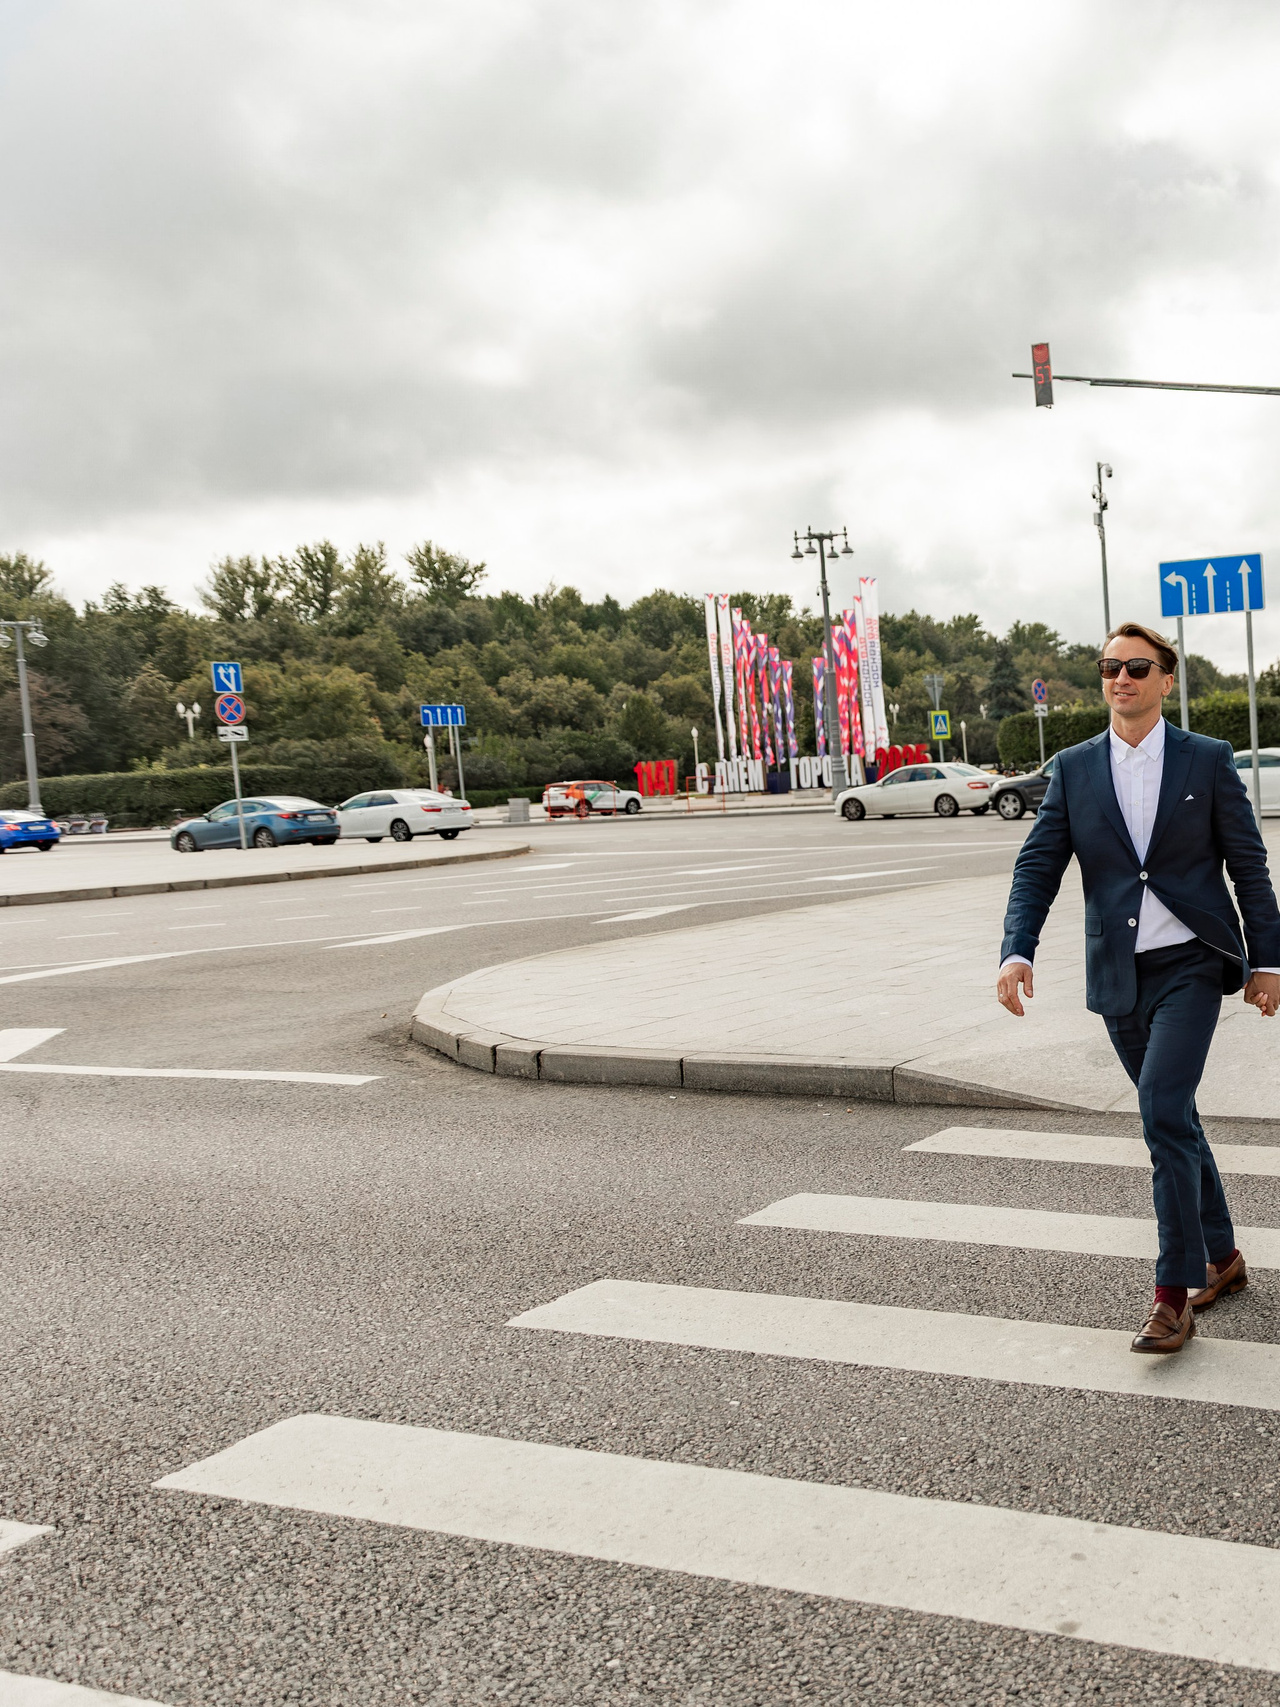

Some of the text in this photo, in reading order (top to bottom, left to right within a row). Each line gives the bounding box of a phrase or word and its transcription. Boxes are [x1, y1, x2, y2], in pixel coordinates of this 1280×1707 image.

[1035, 364, 1051, 384] 57
[633, 759, 675, 797] 1147
[696, 763, 709, 795] С
